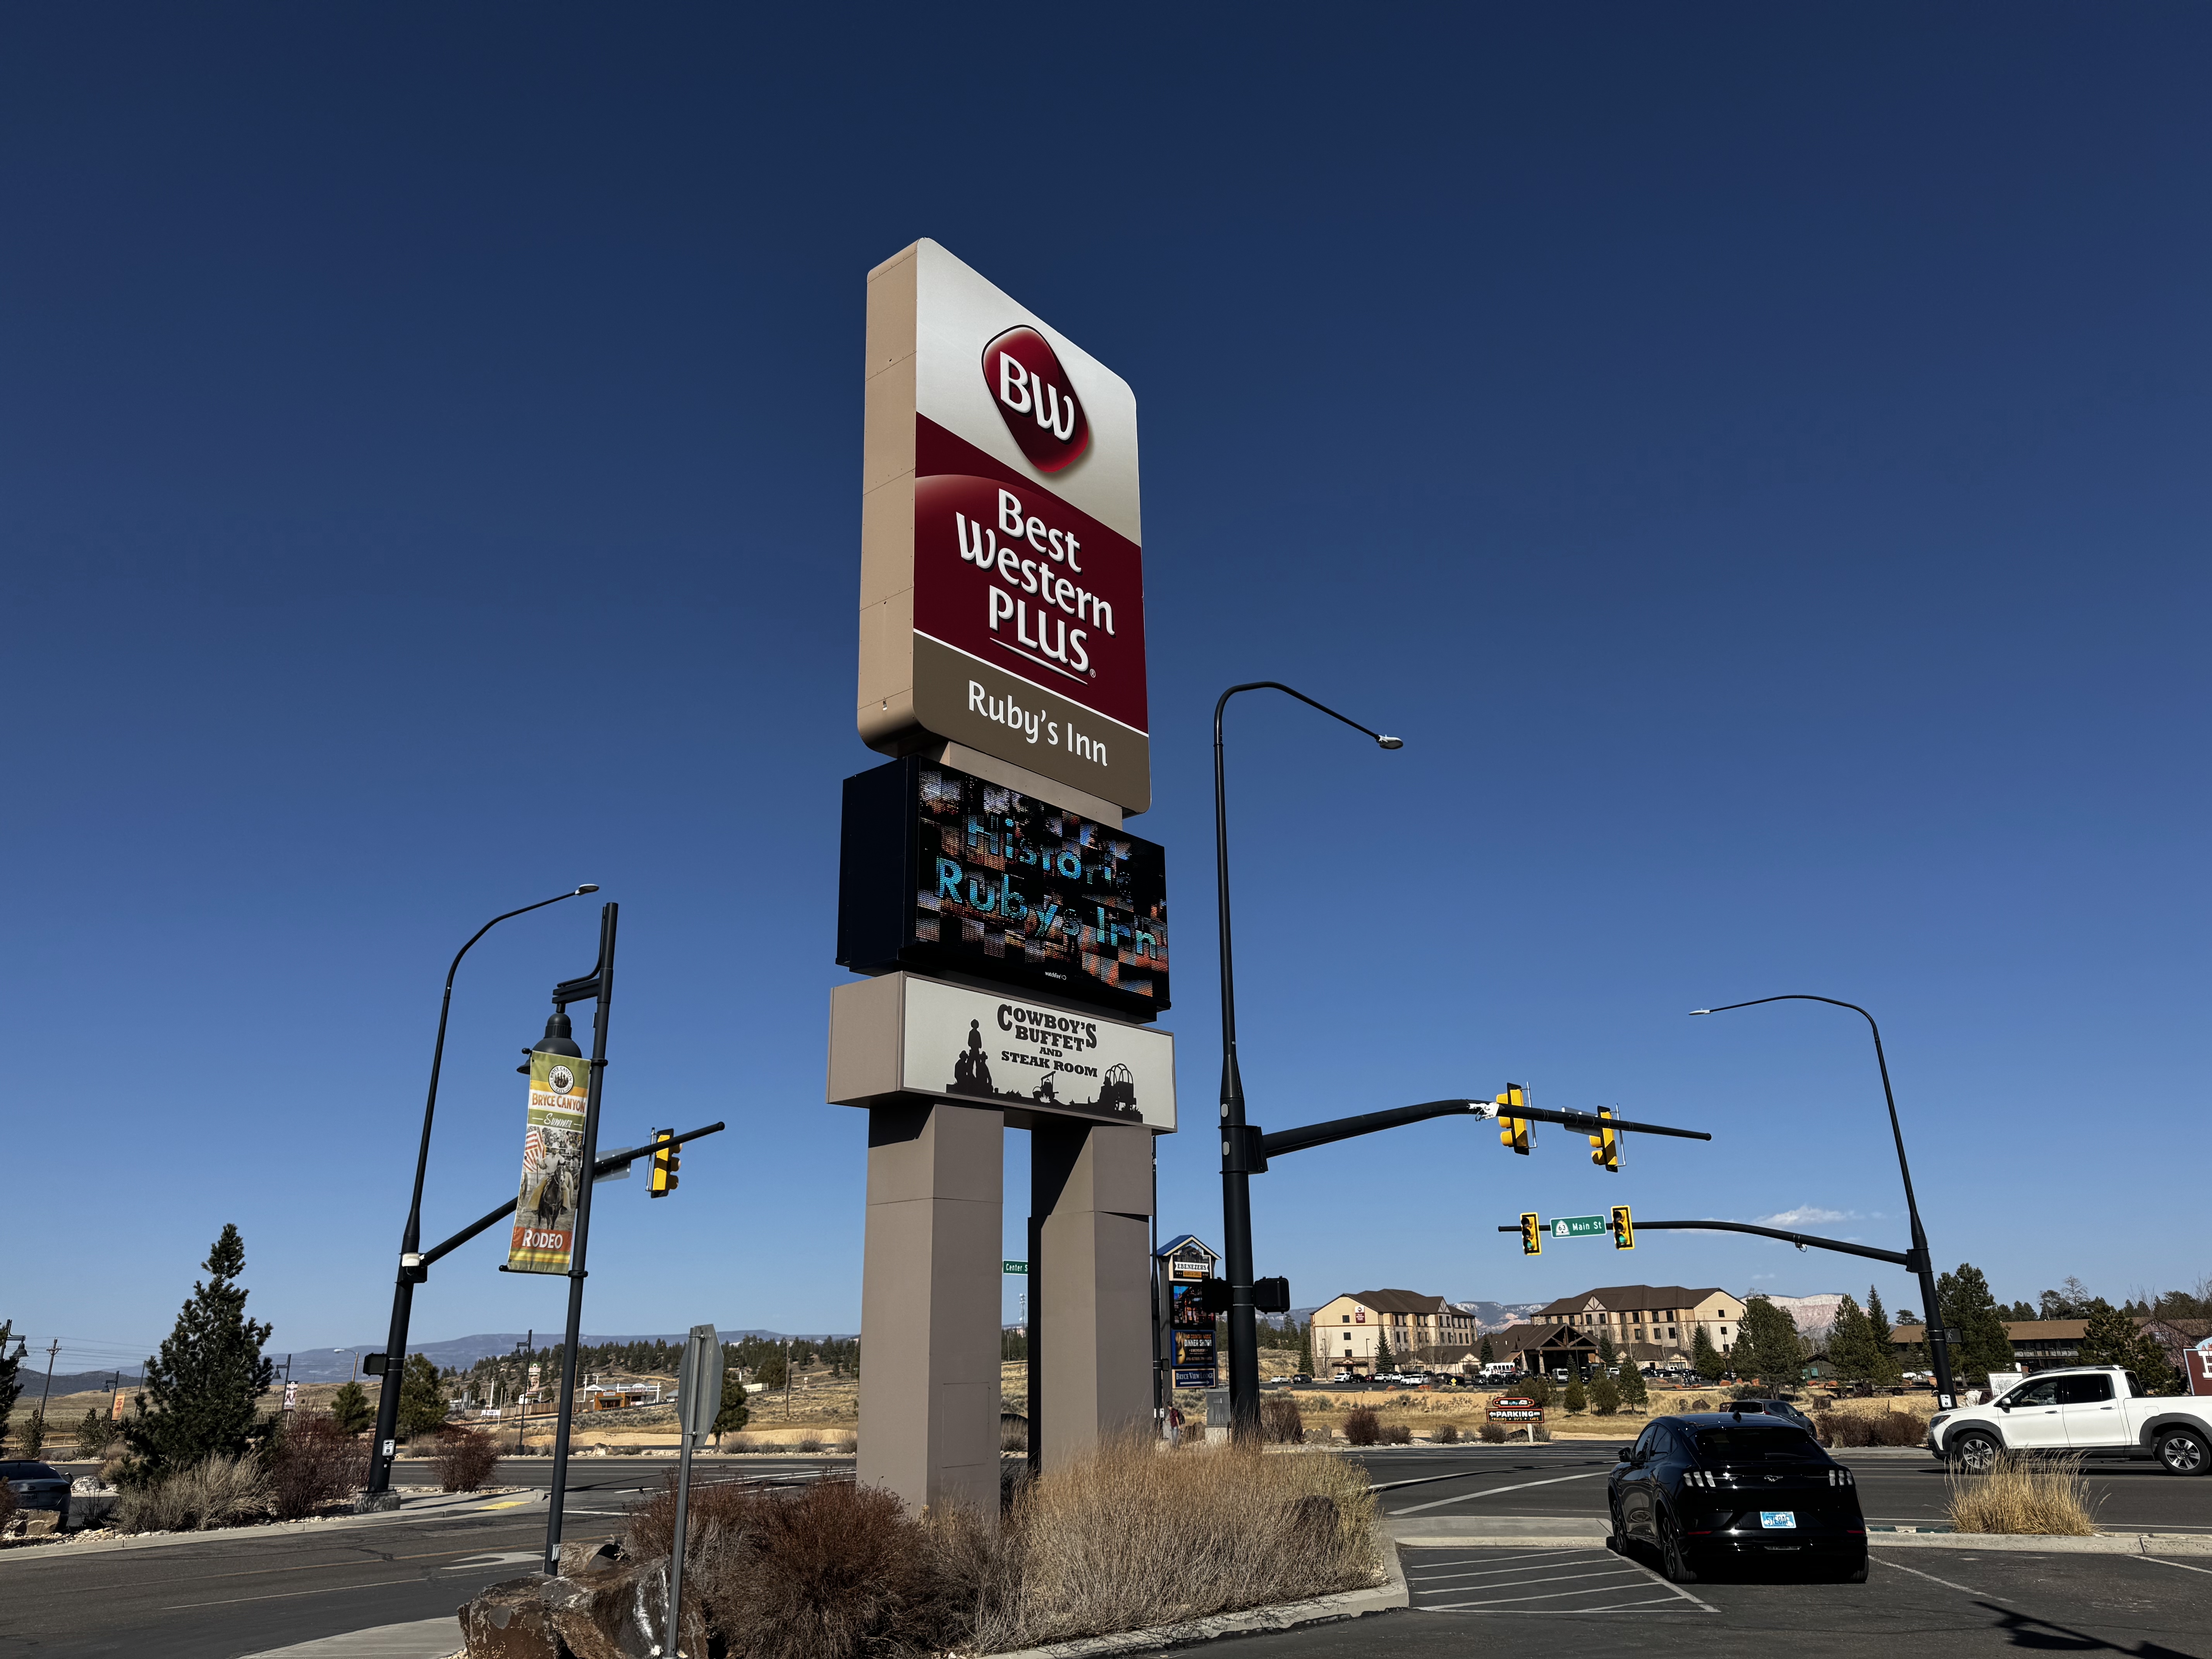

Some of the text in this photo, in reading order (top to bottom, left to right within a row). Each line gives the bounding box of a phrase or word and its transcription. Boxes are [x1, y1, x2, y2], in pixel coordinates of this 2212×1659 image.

[1000, 351, 1074, 441] BW
[999, 488, 1082, 572] Best
[956, 512, 1115, 635] Western
[989, 585, 1089, 672] PLUS
[969, 680, 1108, 766] Ruby's Inn
[997, 1004, 1097, 1049] COWBOY'S
[1015, 1025, 1084, 1052] BUFFET
[1001, 1051, 1098, 1077] STEAK ROOM
[1039, 1047, 1063, 1058] AND
[532, 1092, 586, 1113] BRYCE CANYON
[544, 1113, 572, 1128] Summer
[522, 1229, 563, 1249] RODEO
[1572, 1221, 1602, 1231] Main St
[1006, 1263, 1023, 1271] Center
